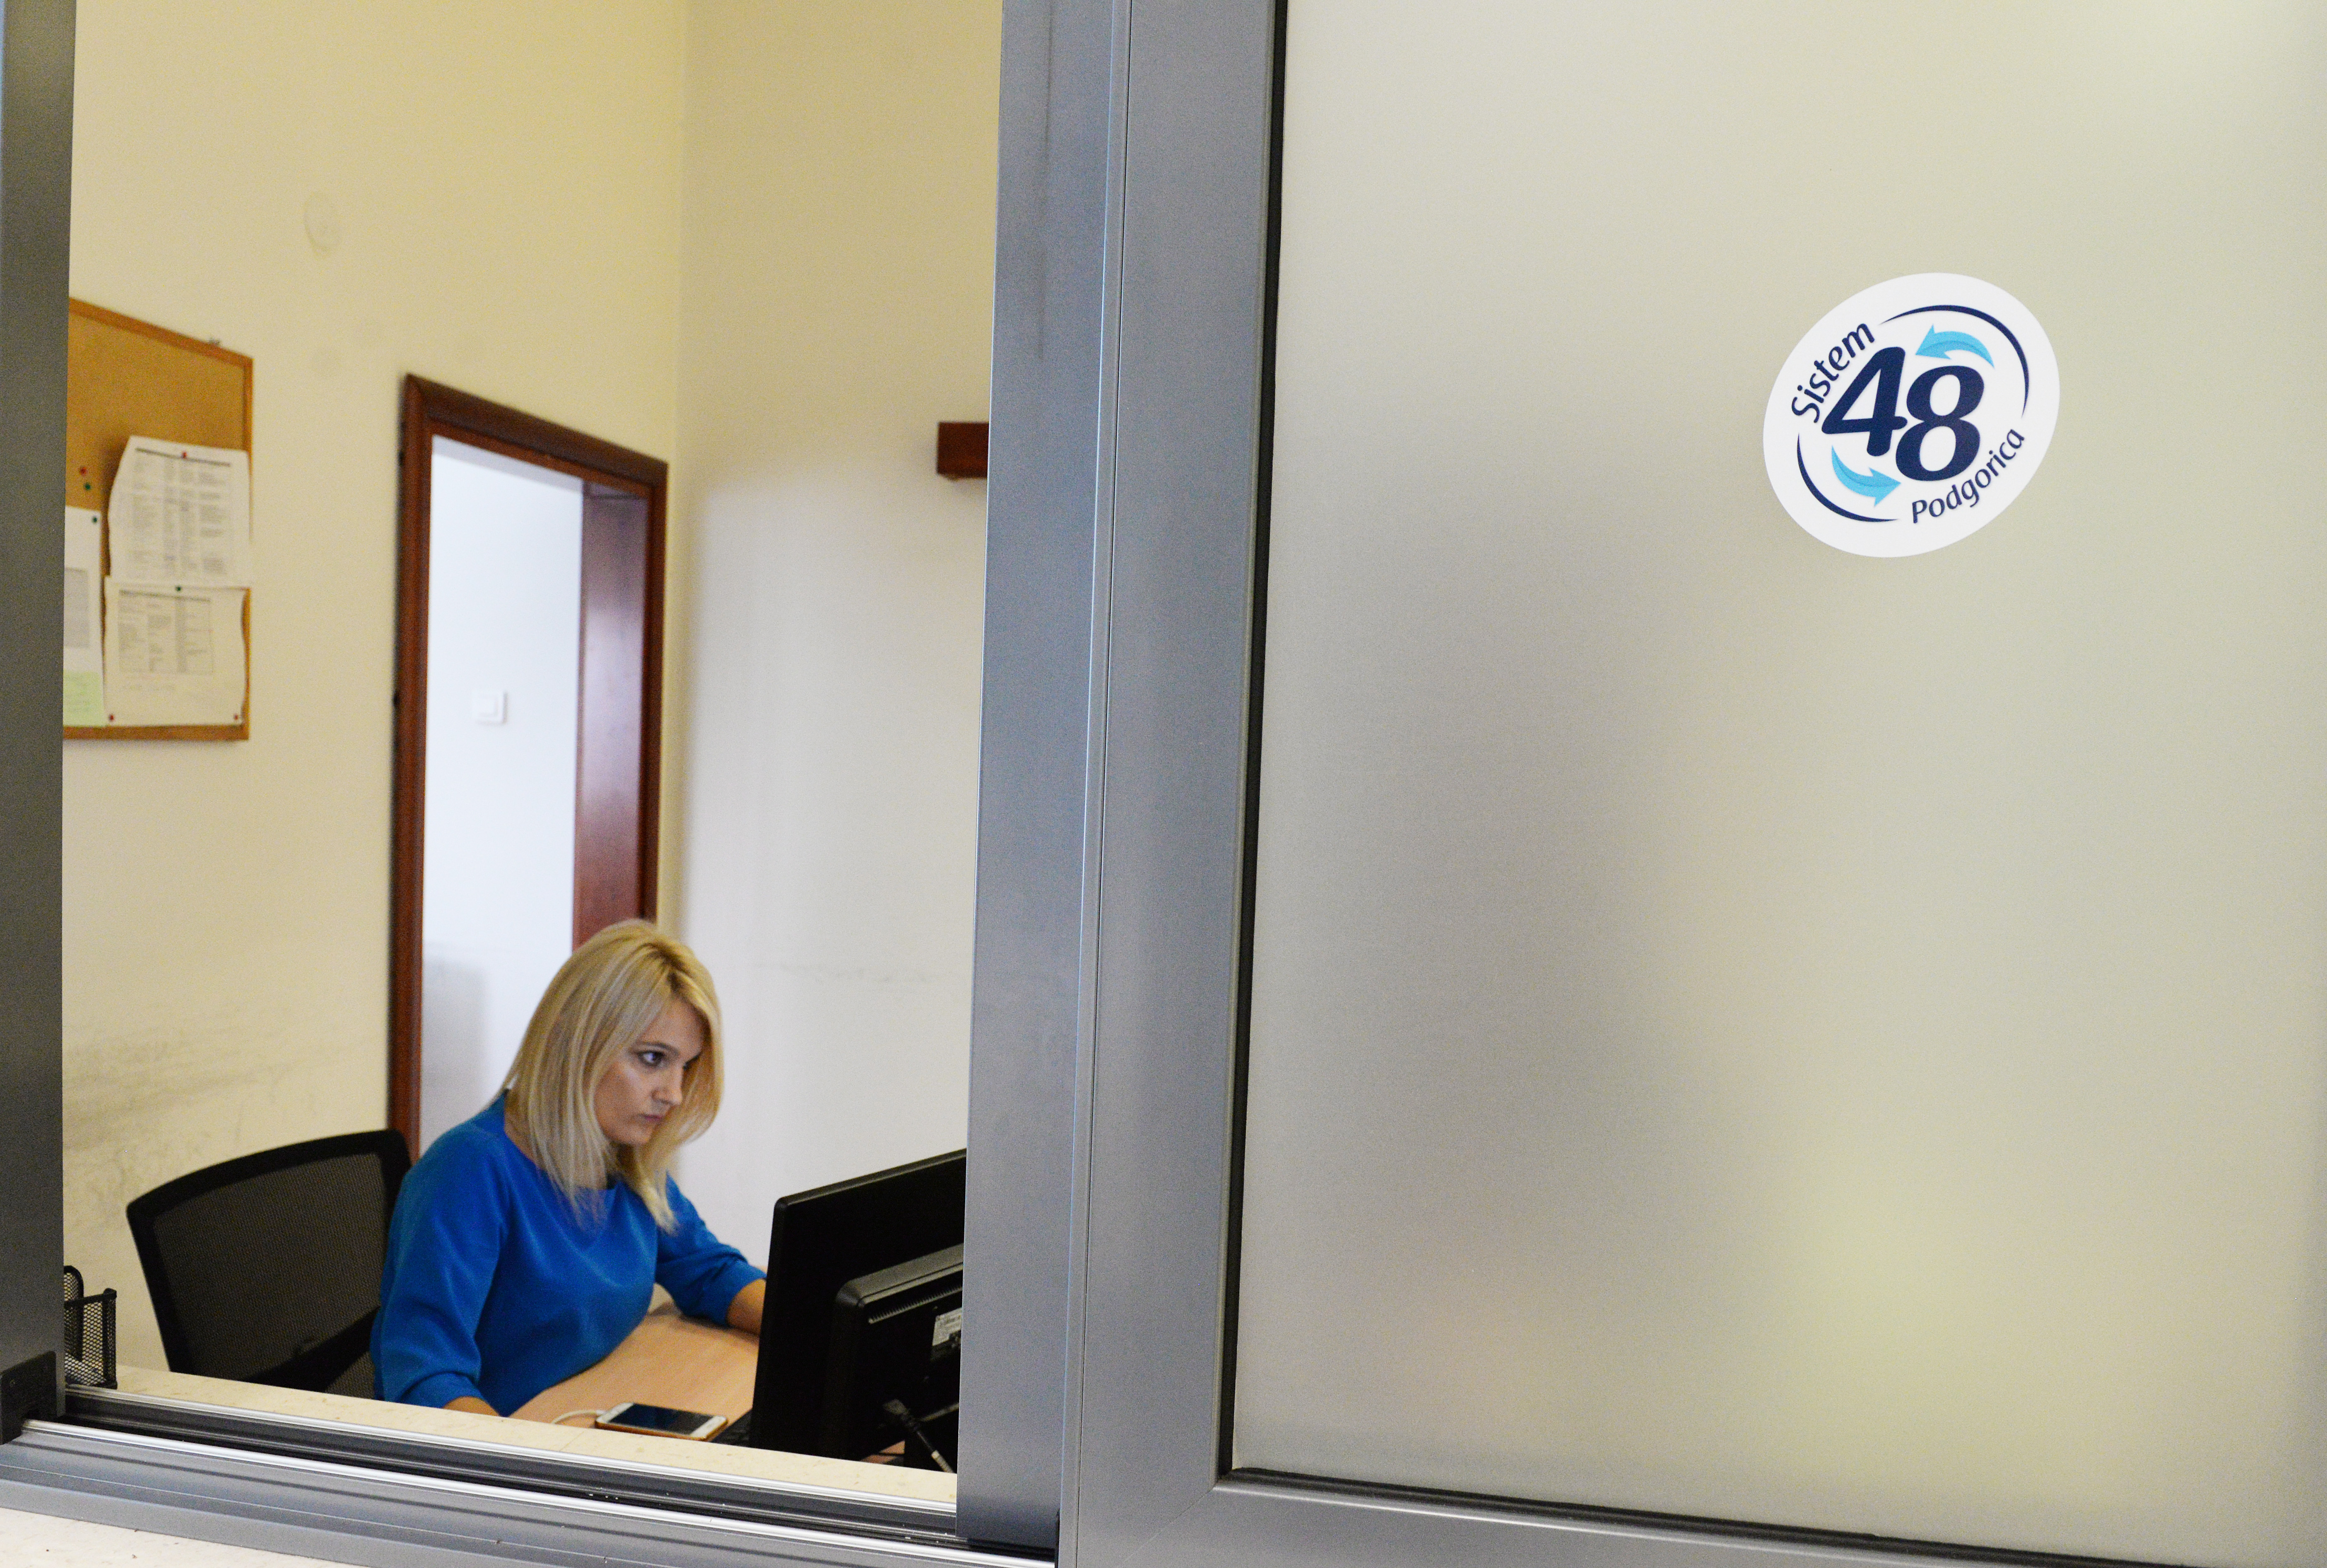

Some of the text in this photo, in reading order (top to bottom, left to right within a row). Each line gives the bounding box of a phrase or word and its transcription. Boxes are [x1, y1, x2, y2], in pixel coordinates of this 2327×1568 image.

[1791, 323, 1875, 423] Sistem
[1821, 346, 1985, 481] 48
[1912, 429, 2025, 524] Podgorica
